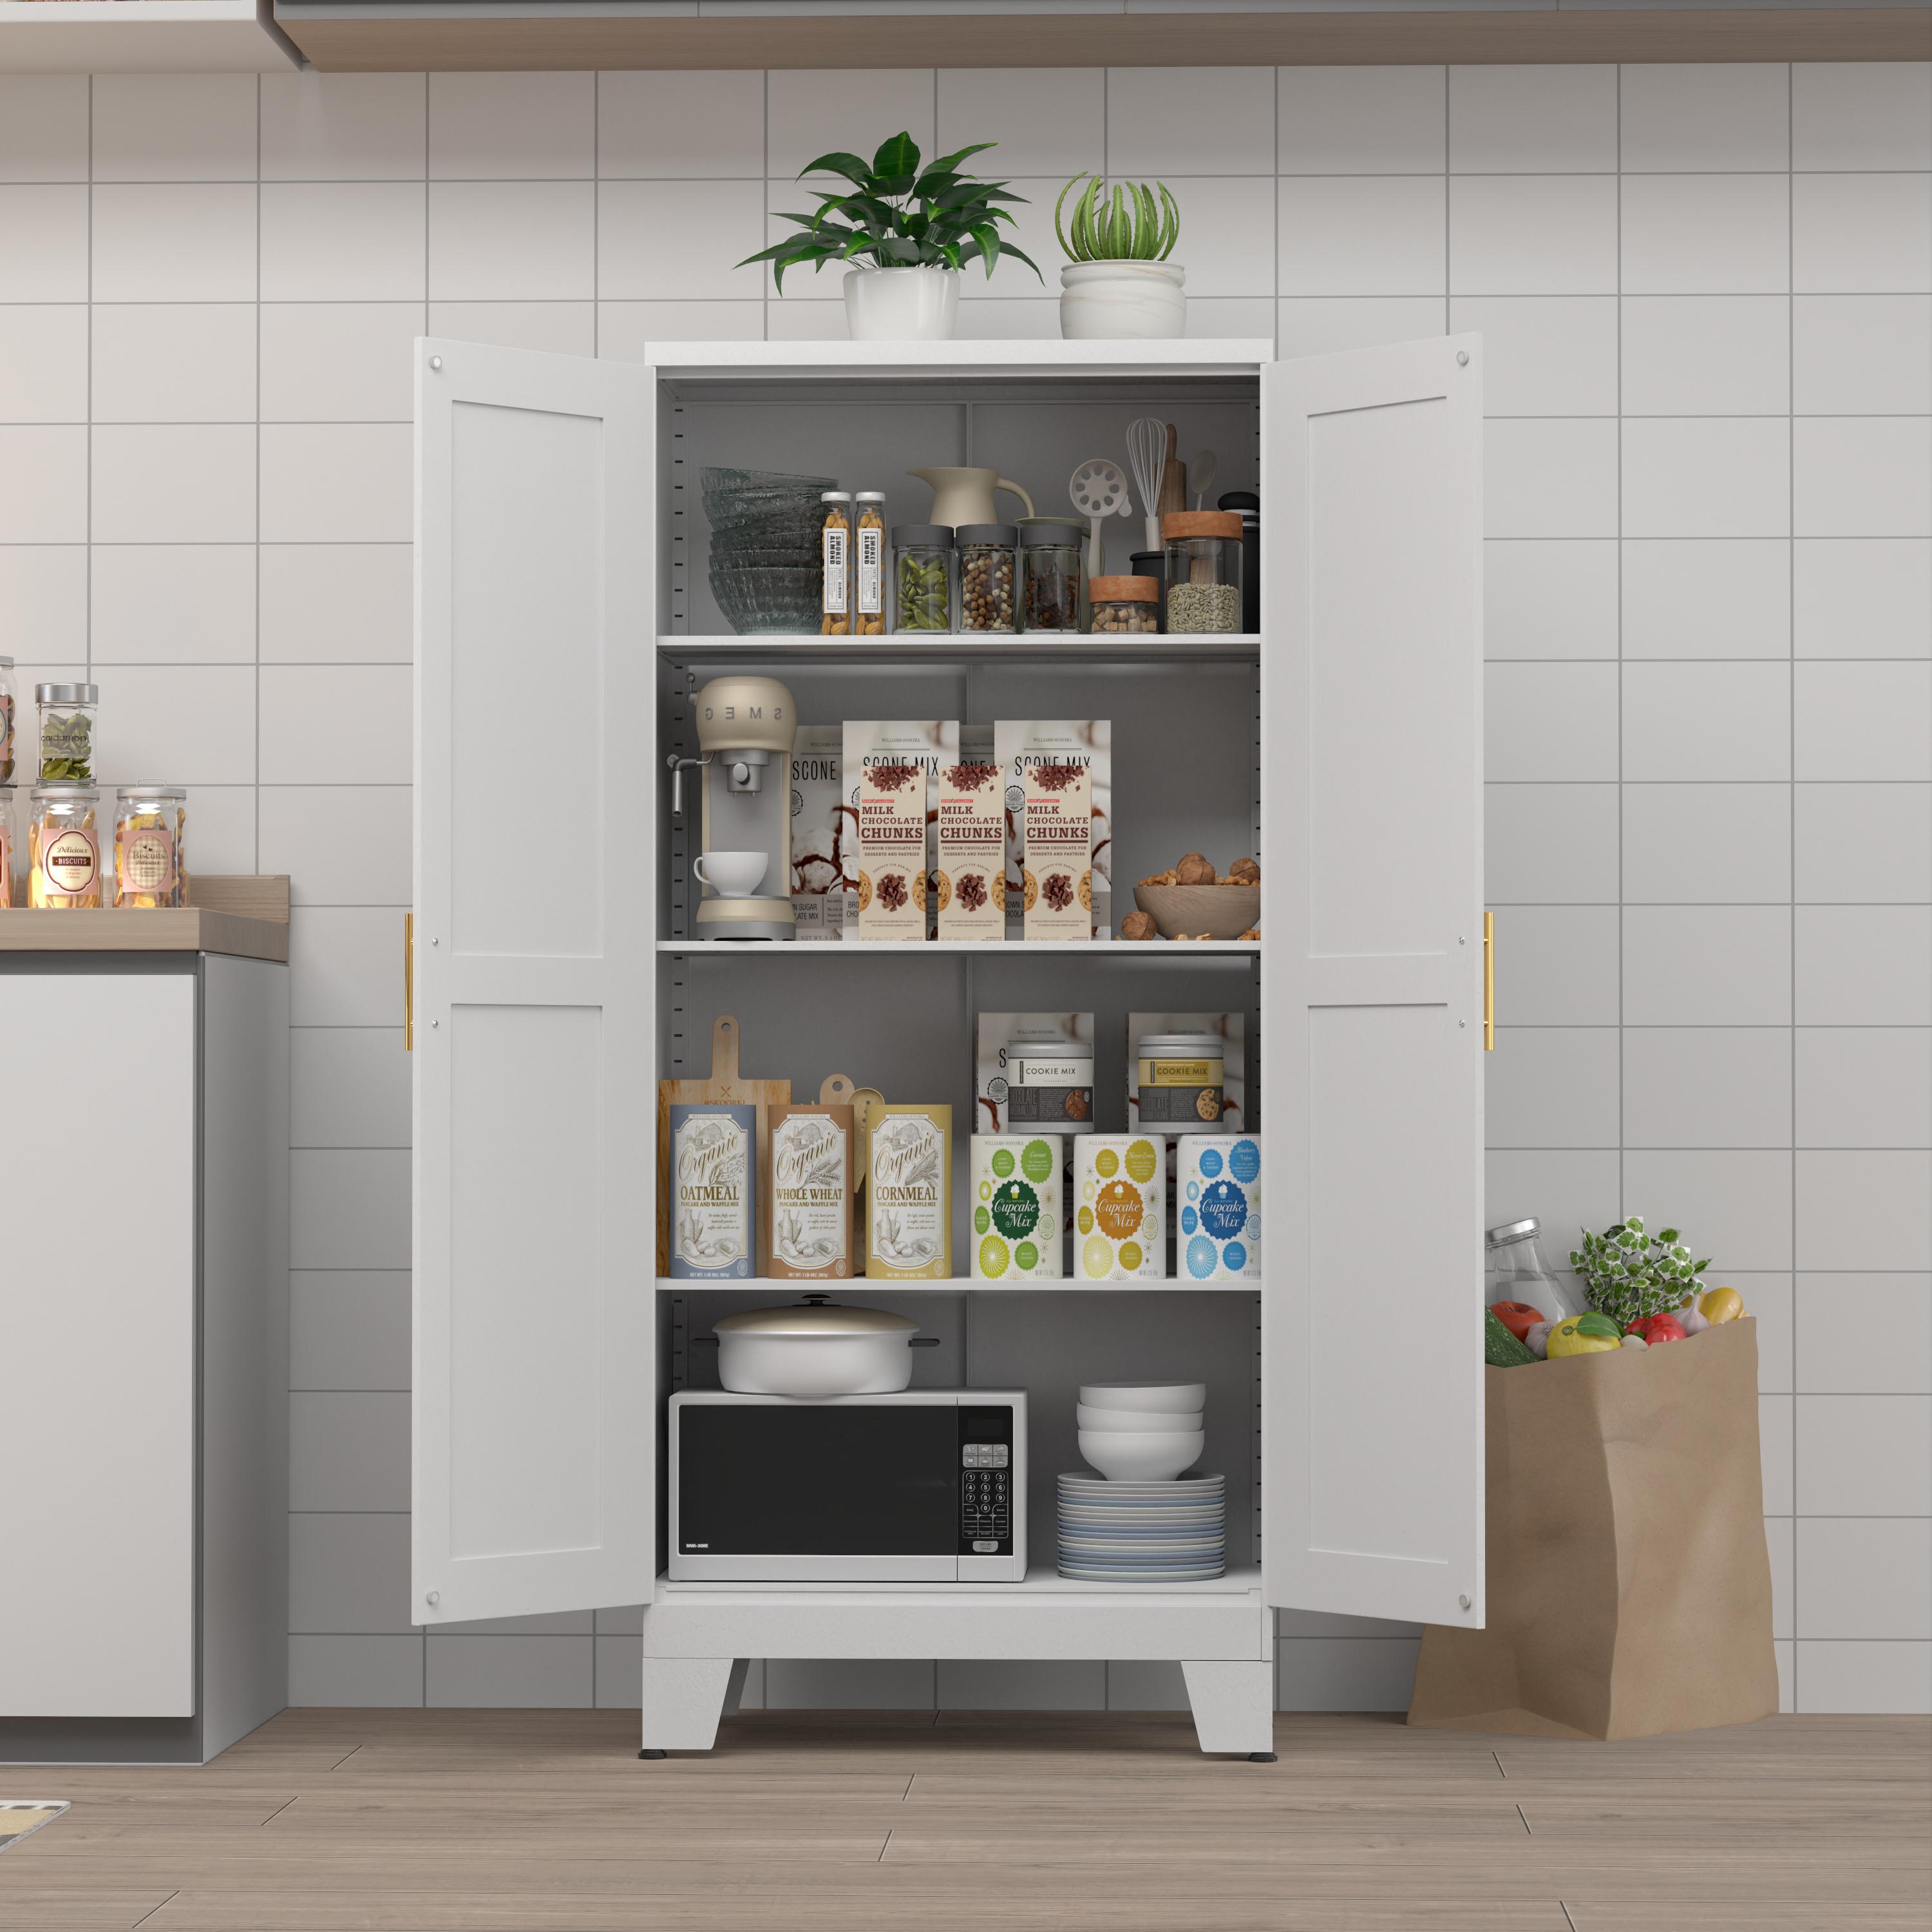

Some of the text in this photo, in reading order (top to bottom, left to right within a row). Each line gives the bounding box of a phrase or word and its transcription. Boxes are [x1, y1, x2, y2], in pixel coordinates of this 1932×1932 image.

[792, 761, 836, 780] SCONE
[861, 828, 923, 838] CHUNKS
[940, 828, 1002, 838] CHUNKS
[1027, 828, 1088, 838] CHUNKS
[133, 851, 165, 859] Biscuits
[679, 1132, 739, 1184] Organic
[777, 1132, 837, 1184] Organic
[875, 1132, 936, 1184] Organic
[681, 1186, 739, 1200] OATMEAL
[776, 1188, 843, 1200] WHOLE WHEAT
[876, 1186, 938, 1200] CORNMEAL
[994, 1198, 1036, 1216] Cupcake
[1098, 1198, 1140, 1216] Cupcake
[1202, 1198, 1244, 1216] Cupcake
[1005, 1213, 1032, 1227] Mix
[1110, 1213, 1136, 1228] Mix
[1213, 1213, 1240, 1228] Mix
